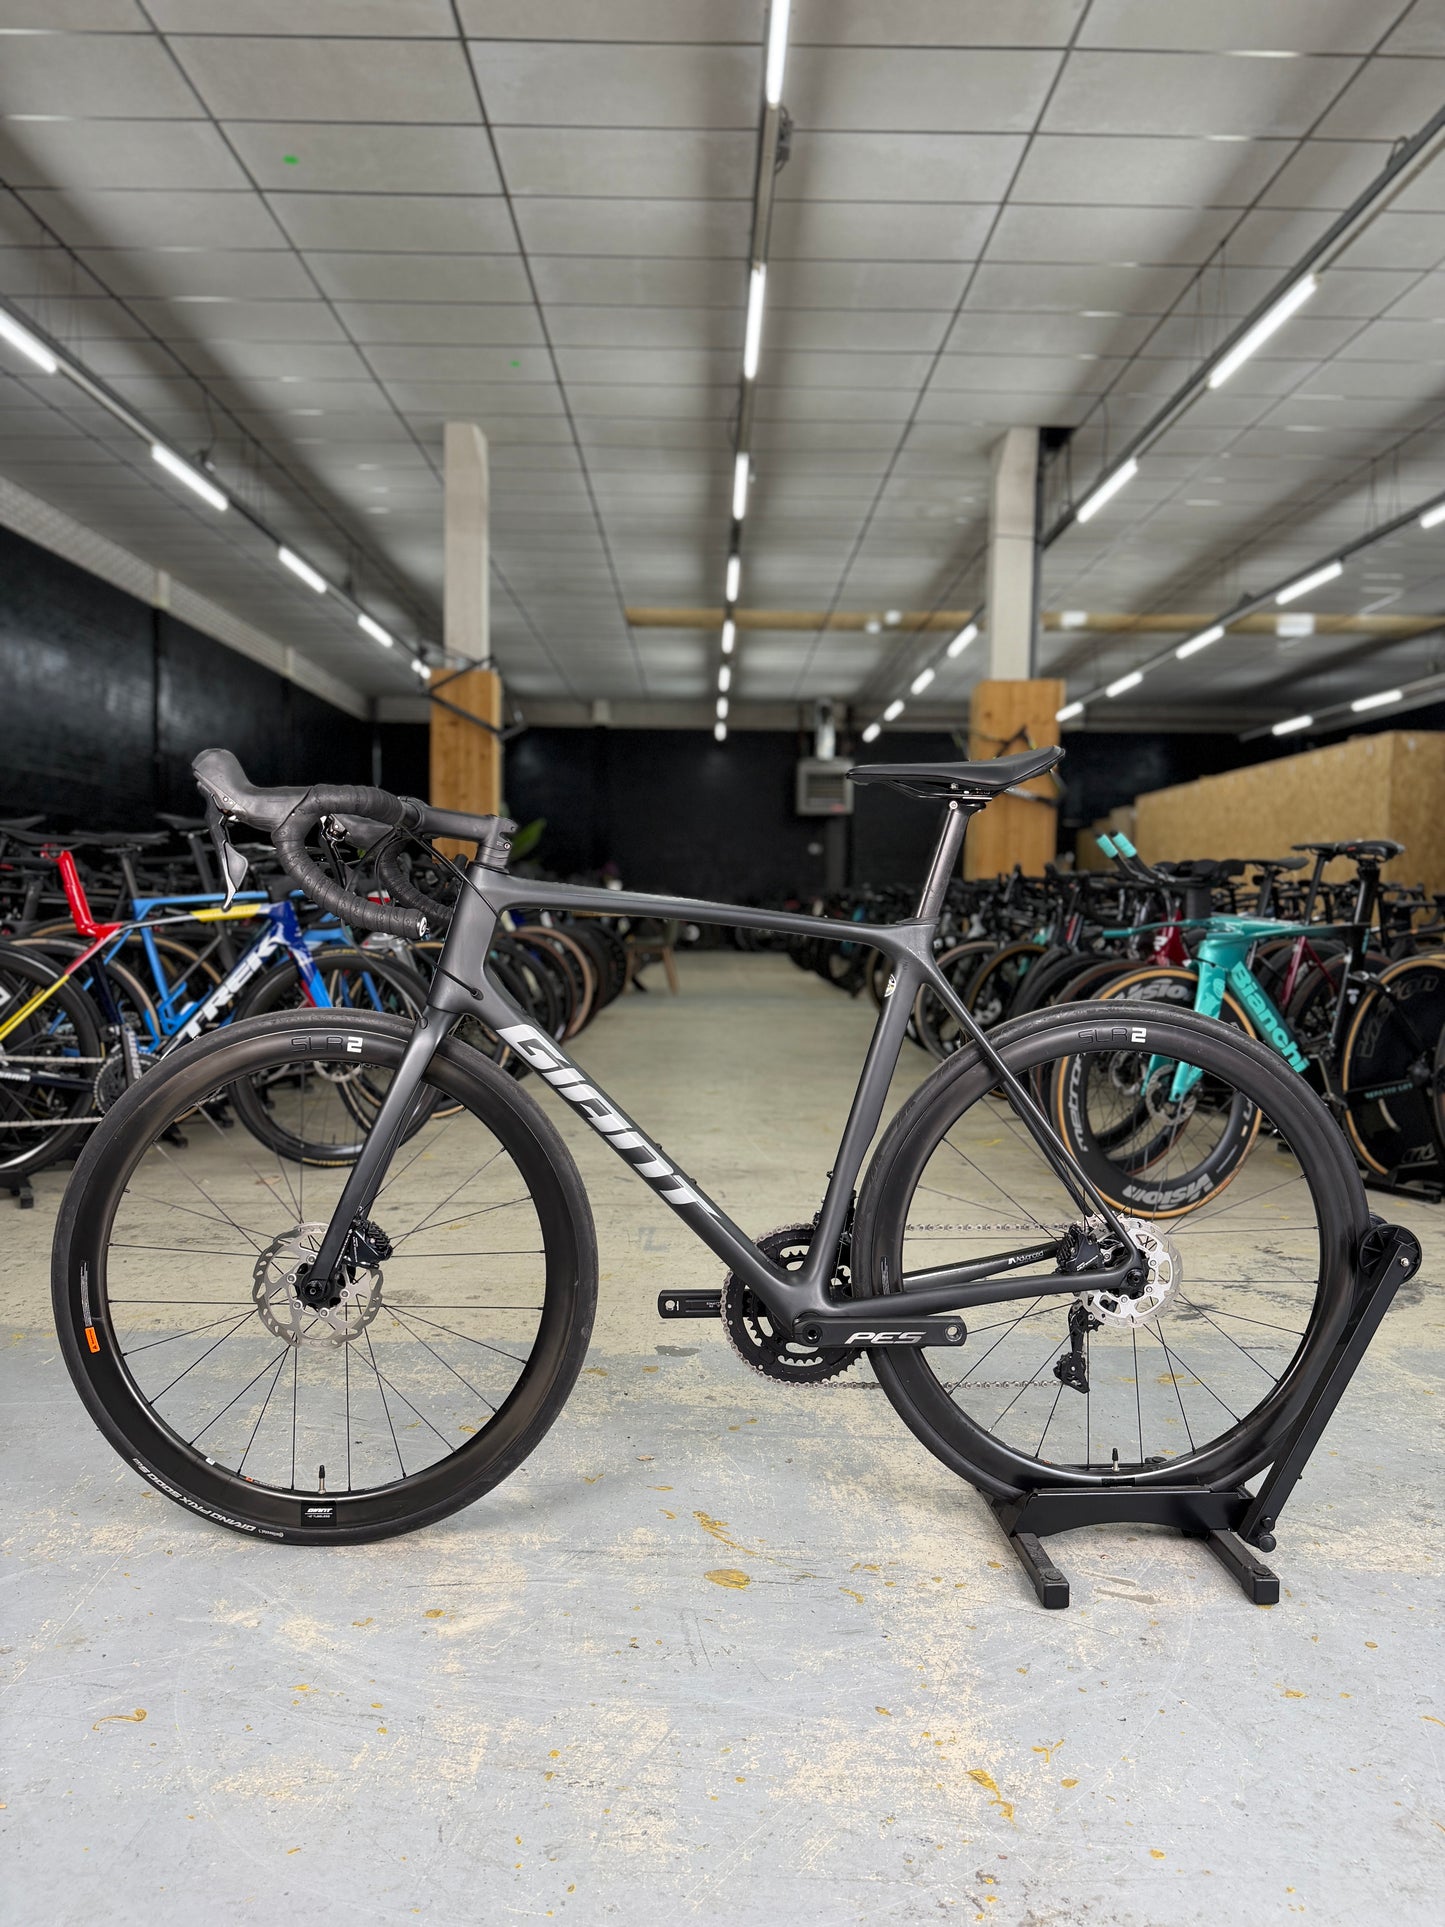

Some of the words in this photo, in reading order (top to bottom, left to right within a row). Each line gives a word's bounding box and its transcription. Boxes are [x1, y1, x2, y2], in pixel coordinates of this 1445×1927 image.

[176, 933, 279, 1040] TREK
[1231, 961, 1310, 1074] Bianchi
[495, 1023, 723, 1219] GIANT
[1016, 1250, 1045, 1262] Advanced
[146, 1471, 182, 1499] 5000
[179, 1495, 213, 1515] PRIX
[209, 1511, 257, 1532] GRAND
